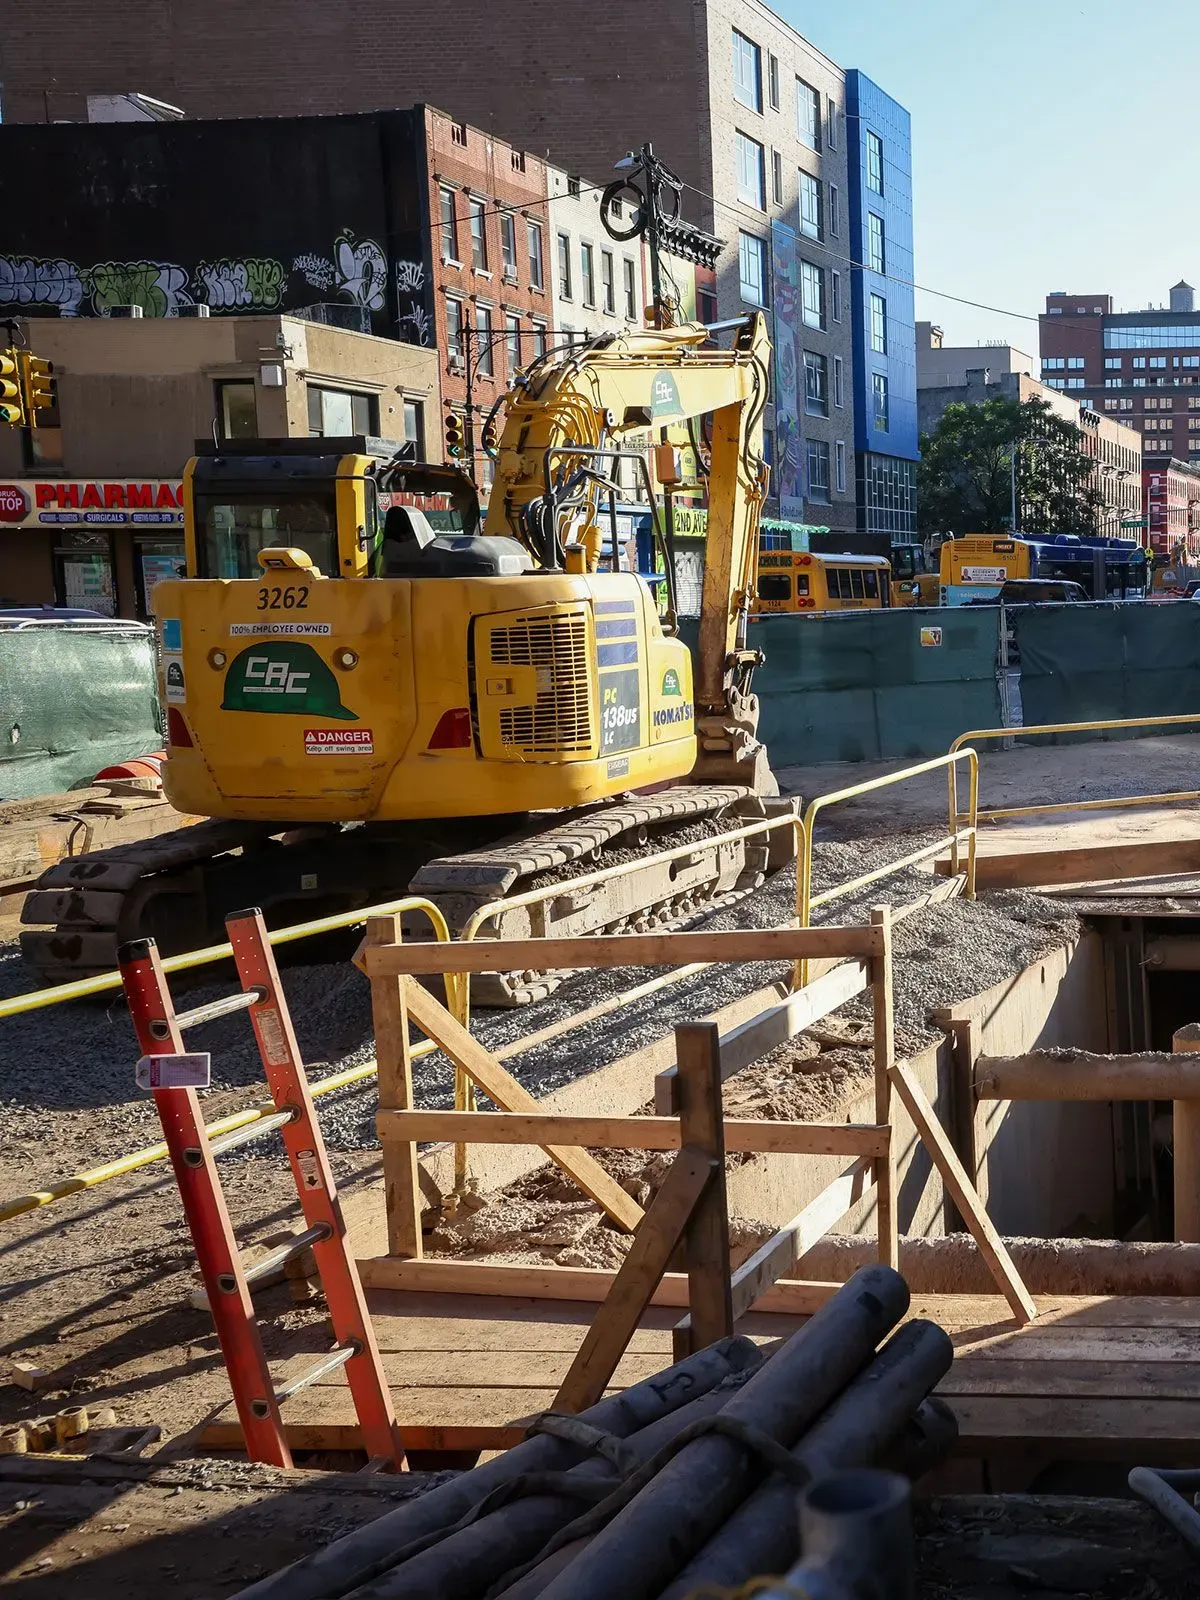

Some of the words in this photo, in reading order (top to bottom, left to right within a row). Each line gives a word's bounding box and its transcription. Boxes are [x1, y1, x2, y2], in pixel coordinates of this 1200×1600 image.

[0, 497, 22, 510] TOP
[35, 484, 184, 509] PHARMA
[392, 491, 454, 511] PHARM
[86, 513, 124, 522] SURGICALS
[675, 513, 691, 532] 2ND
[256, 586, 310, 611] 3262
[231, 625, 251, 634] 100%
[252, 625, 294, 633] EMPLOYEE
[296, 624, 330, 634] OWNED
[245, 656, 311, 694] CAC
[604, 687, 618, 705] PC
[318, 731, 371, 742] DANGER
[605, 731, 615, 745] LC
[306, 745, 322, 753] Keep
[335, 745, 355, 753] swing
